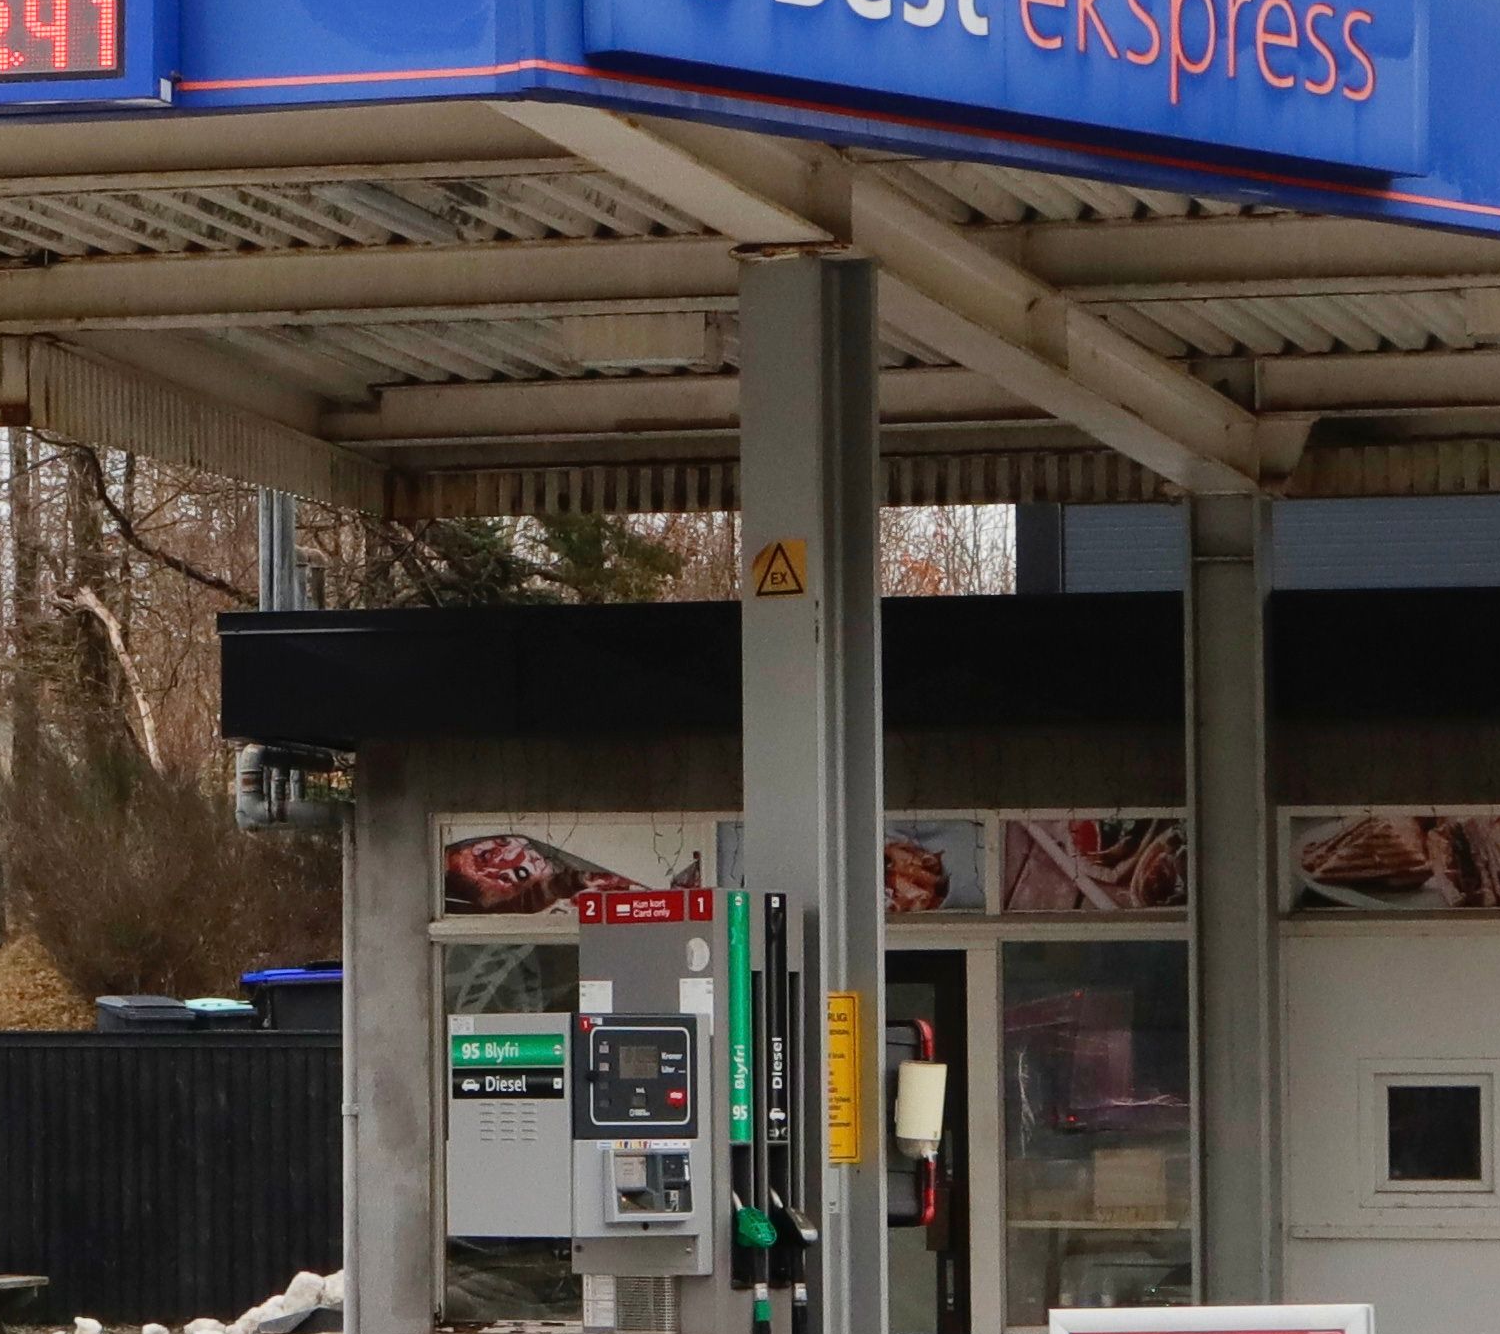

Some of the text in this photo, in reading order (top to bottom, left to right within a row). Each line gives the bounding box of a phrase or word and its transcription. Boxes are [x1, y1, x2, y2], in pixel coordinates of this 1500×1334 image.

[770, 571, 788, 585] EX
[586, 900, 596, 916] 2
[650, 899, 666, 908] kort
[697, 897, 704, 913] 1
[633, 909, 670, 918] Card only
[461, 1042, 519, 1063] 95 Blyfri
[772, 1037, 782, 1089] Diesel
[485, 1075, 527, 1092] Diesel
[733, 1044, 748, 1120] 95 Blyfri
